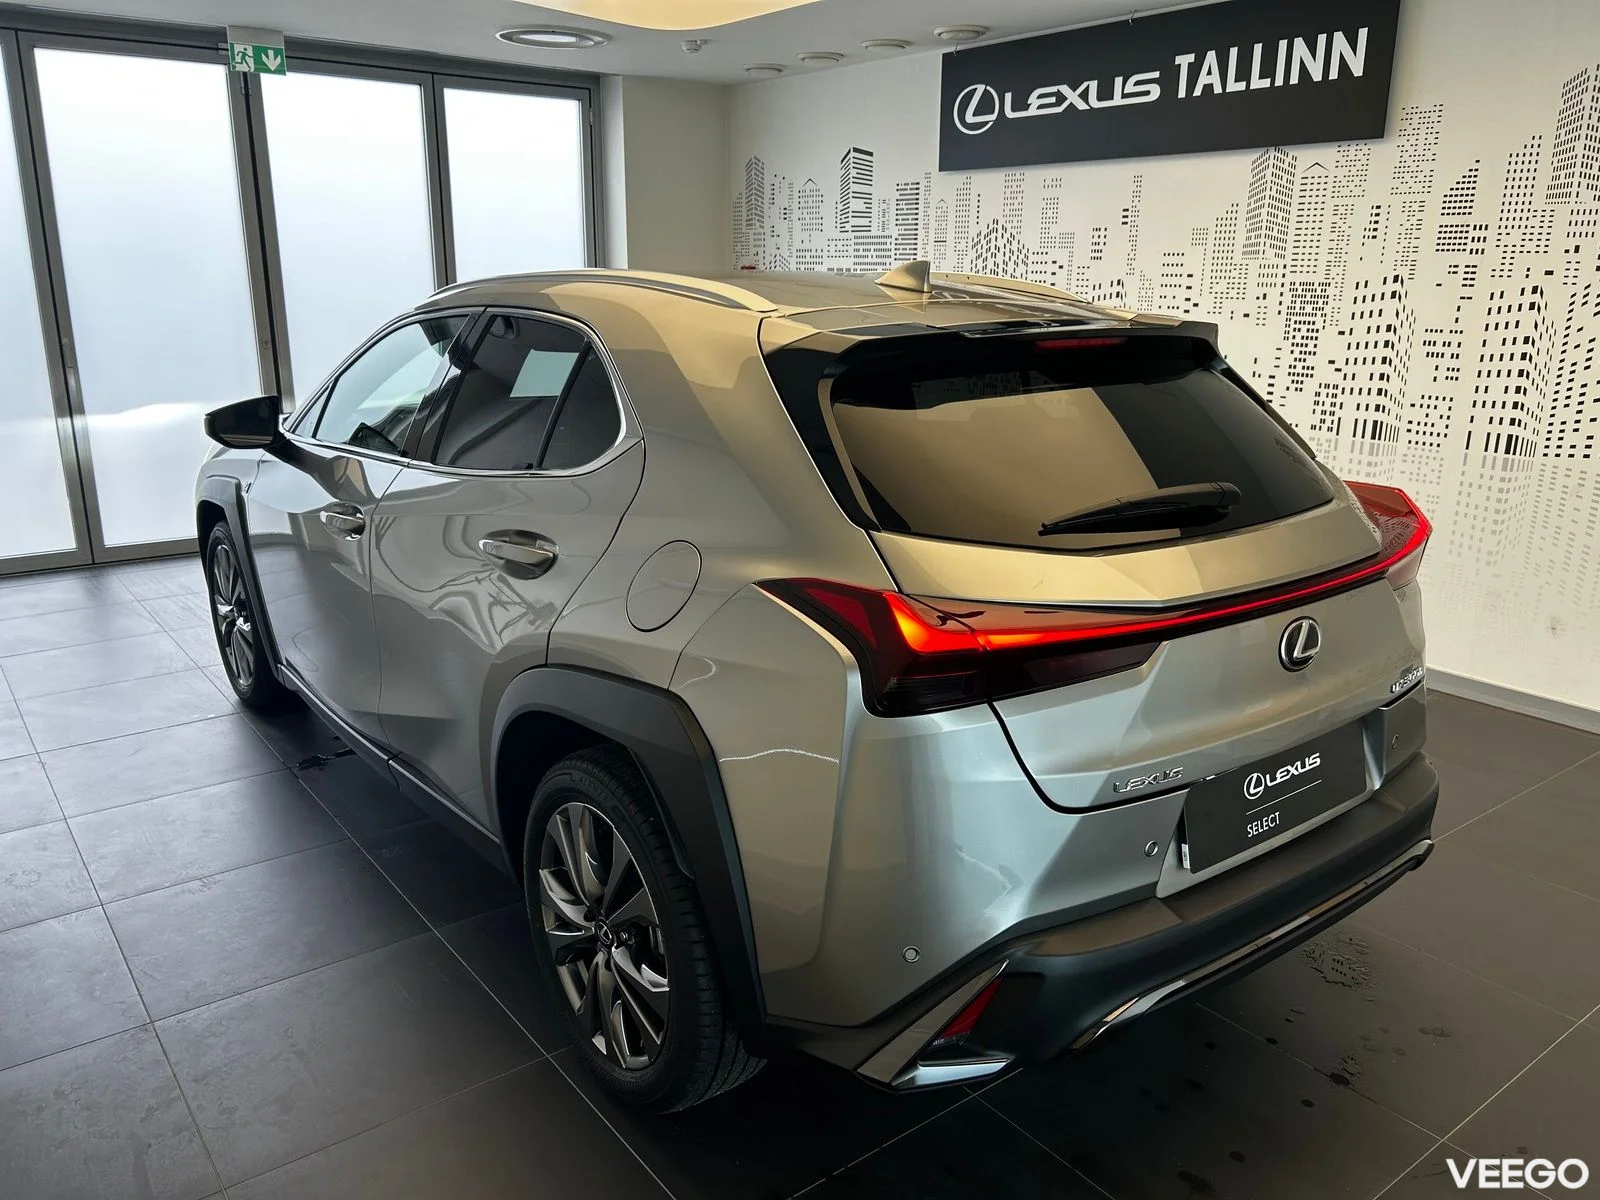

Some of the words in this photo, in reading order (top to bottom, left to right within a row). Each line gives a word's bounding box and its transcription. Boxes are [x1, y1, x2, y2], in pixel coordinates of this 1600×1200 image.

[1004, 71, 1160, 119] LEXUS
[1175, 27, 1369, 98] TALLINN
[1113, 767, 1184, 793] LEXUS
[1265, 752, 1321, 787] LEXUS
[1247, 811, 1280, 838] SELECT
